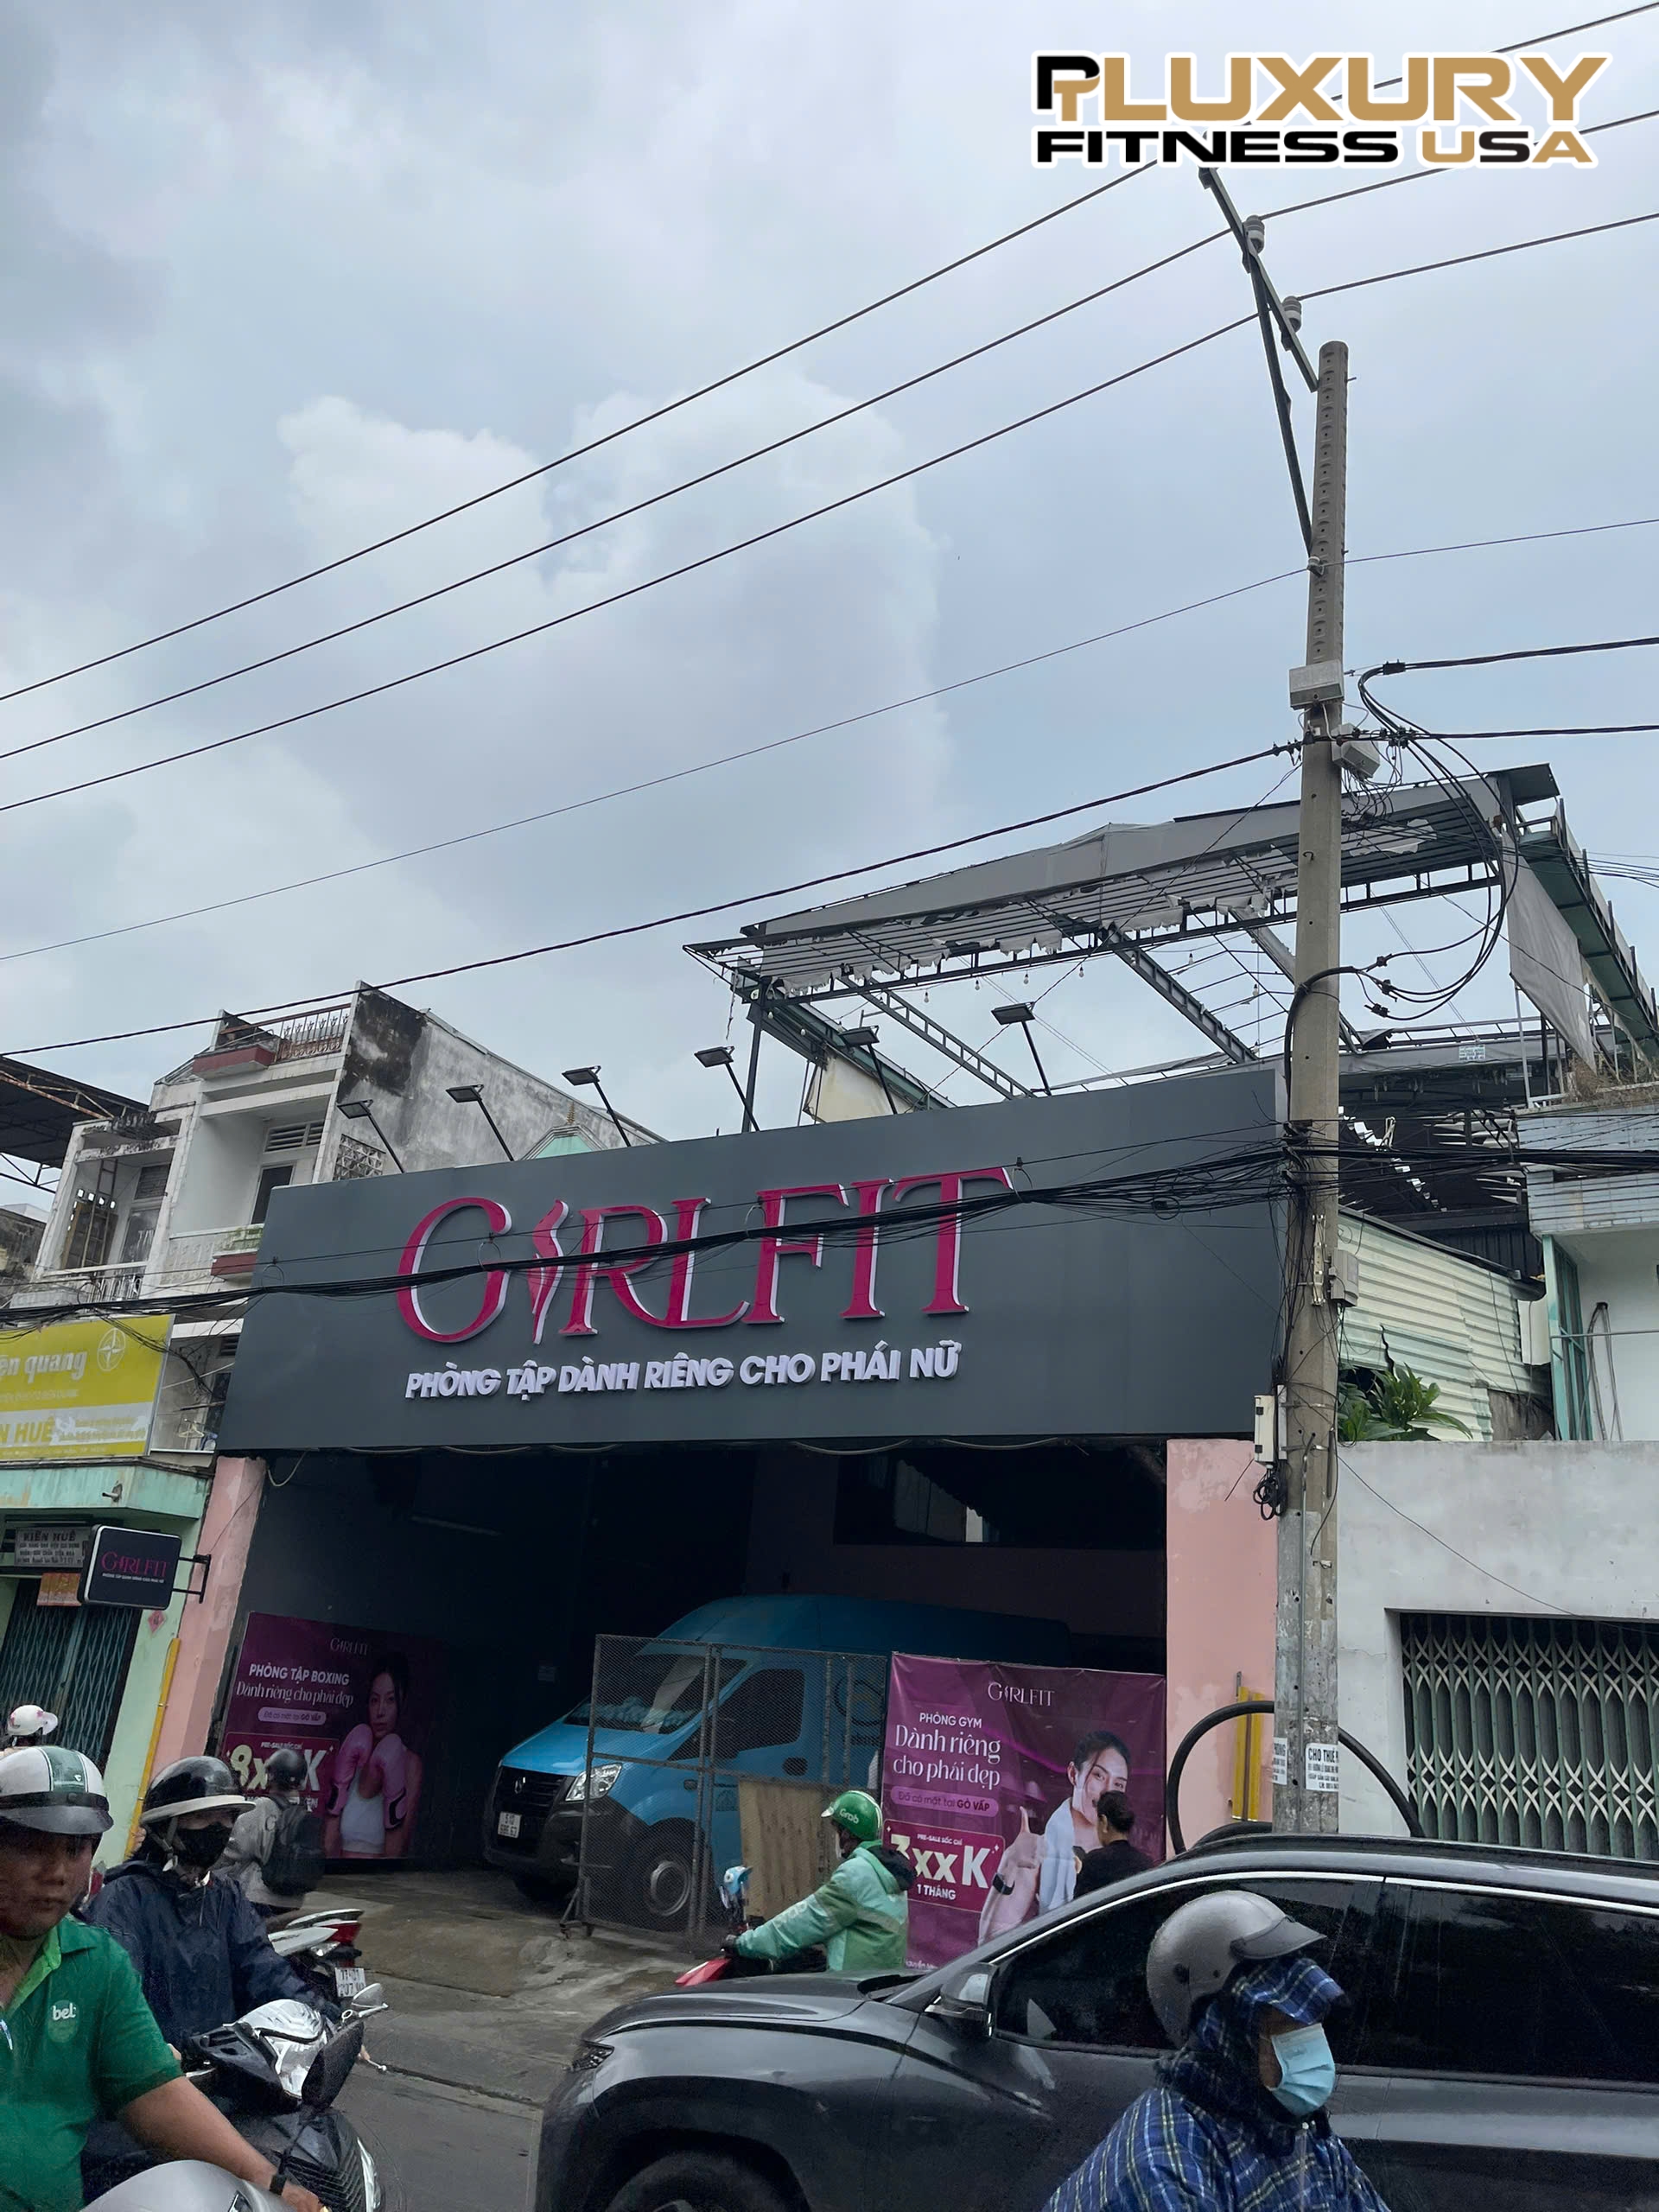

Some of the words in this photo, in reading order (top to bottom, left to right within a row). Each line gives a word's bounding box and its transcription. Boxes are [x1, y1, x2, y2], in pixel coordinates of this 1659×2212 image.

[24, 1350, 87, 1384] quang
[404, 1361, 502, 1399] PHÒNG
[505, 1359, 557, 1402] TẬP
[557, 1356, 639, 1393] DÀNH
[644, 1351, 735, 1389] RIÊNG
[739, 1352, 817, 1386] CHO
[820, 1340, 903, 1382] PHÁI
[908, 1338, 963, 1379] NỮ
[249, 1662, 289, 1680] PHÒNG
[290, 1666, 310, 1684] TẬP
[311, 1670, 350, 1686] BOXING
[293, 1687, 312, 1702] cho
[988, 1681, 1055, 1707] GIRLFIT
[919, 1711, 957, 1726] PHÒNG
[958, 1716, 982, 1729] GYM
[895, 1724, 946, 1752] Dành
[950, 1731, 1001, 1765] riêng
[1308, 1747, 1322, 1762] CHO
[893, 1755, 924, 1777] cho
[925, 1759, 964, 1783] phái
[957, 1798, 971, 1809] GÒ
[973, 1799, 990, 1812] VẤP
[839, 1808, 860, 1825] Grab
[917, 1884, 922, 1894] 1
[923, 1884, 957, 1900] THÁNG
